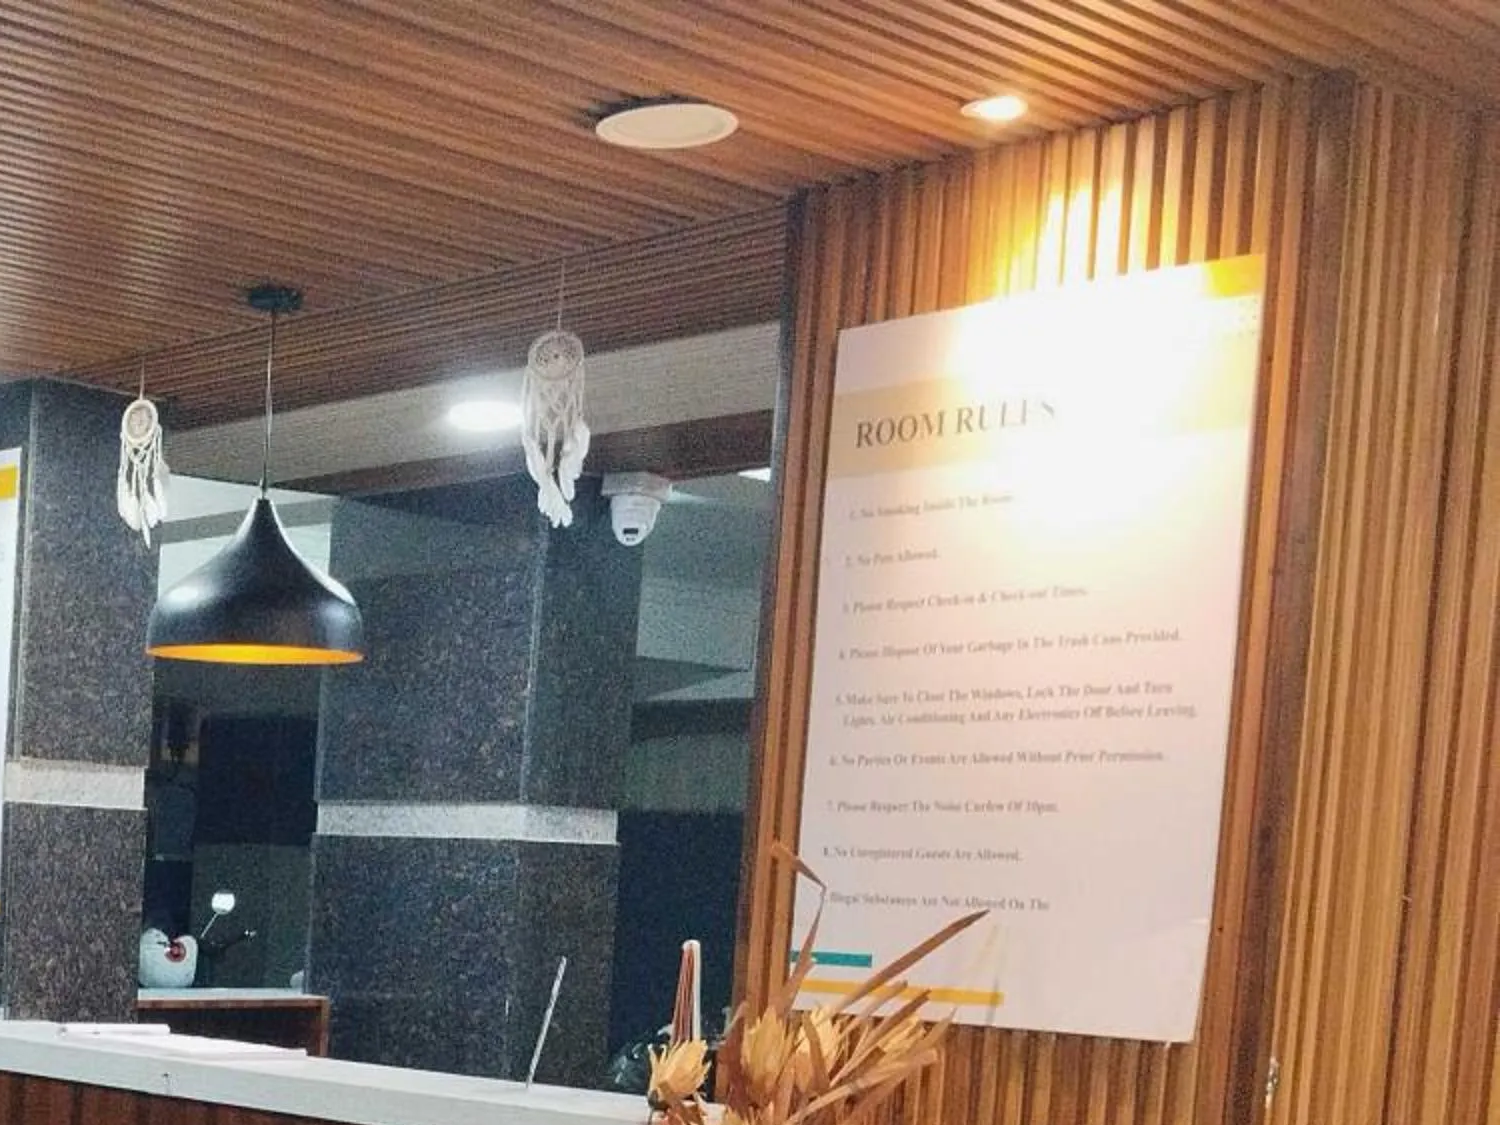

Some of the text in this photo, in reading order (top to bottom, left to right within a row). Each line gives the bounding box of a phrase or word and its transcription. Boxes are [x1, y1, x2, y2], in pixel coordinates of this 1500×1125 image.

[854, 408, 946, 449] ROOM
[967, 639, 1014, 654] Garbage
[1033, 636, 1054, 648] The
[917, 689, 945, 702] Close
[949, 688, 969, 701] The
[1027, 685, 1054, 698] Lock
[1058, 684, 1080, 697] The
[1084, 683, 1111, 696] Door
[1117, 682, 1140, 694] And
[898, 710, 965, 726] Conditioning
[970, 710, 990, 721] And
[995, 710, 1015, 723] Any
[1083, 705, 1103, 718] Off
[1105, 704, 1143, 718] Before
[949, 752, 967, 764] Are
[972, 751, 1012, 763] Allowed
[1015, 750, 1061, 762] Without
[912, 799, 930, 811] The
[1007, 800, 1023, 811] Of
[954, 848, 972, 860] Are
[921, 894, 938, 906] Are
[941, 894, 960, 906] Not
[964, 895, 1006, 909] Allowed
[1008, 897, 1024, 910] On
[1030, 896, 1051, 910] The
